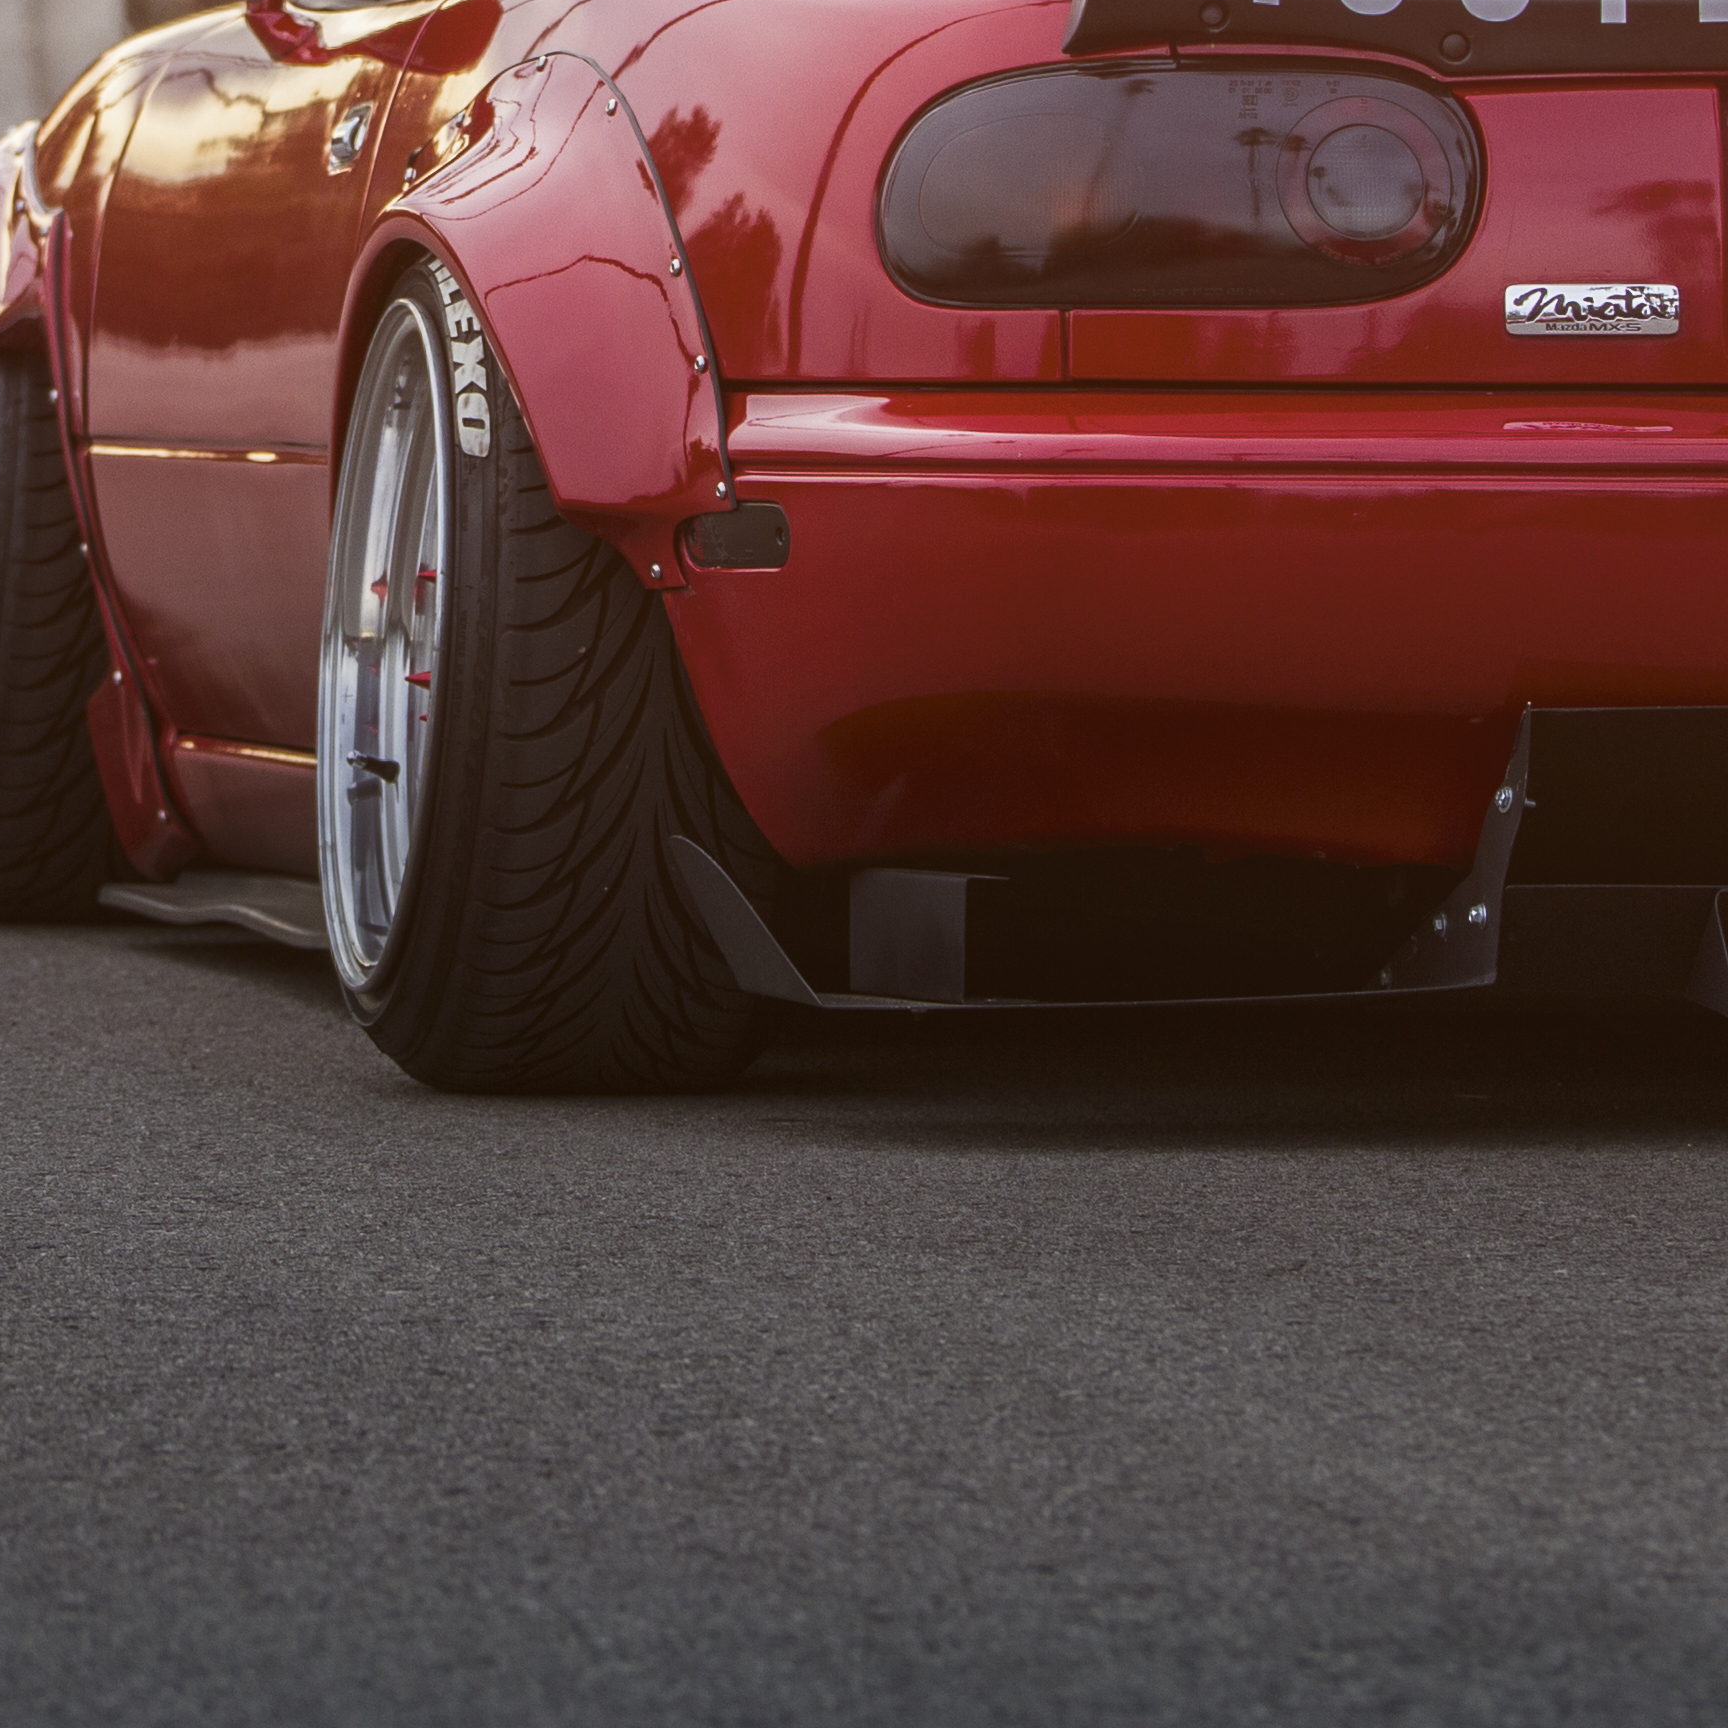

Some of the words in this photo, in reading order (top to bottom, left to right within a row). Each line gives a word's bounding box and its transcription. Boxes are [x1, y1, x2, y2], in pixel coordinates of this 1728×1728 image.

[1513, 287, 1672, 323] Miata
[1545, 323, 1587, 332] Mazda
[1588, 323, 1642, 332] MX-5
